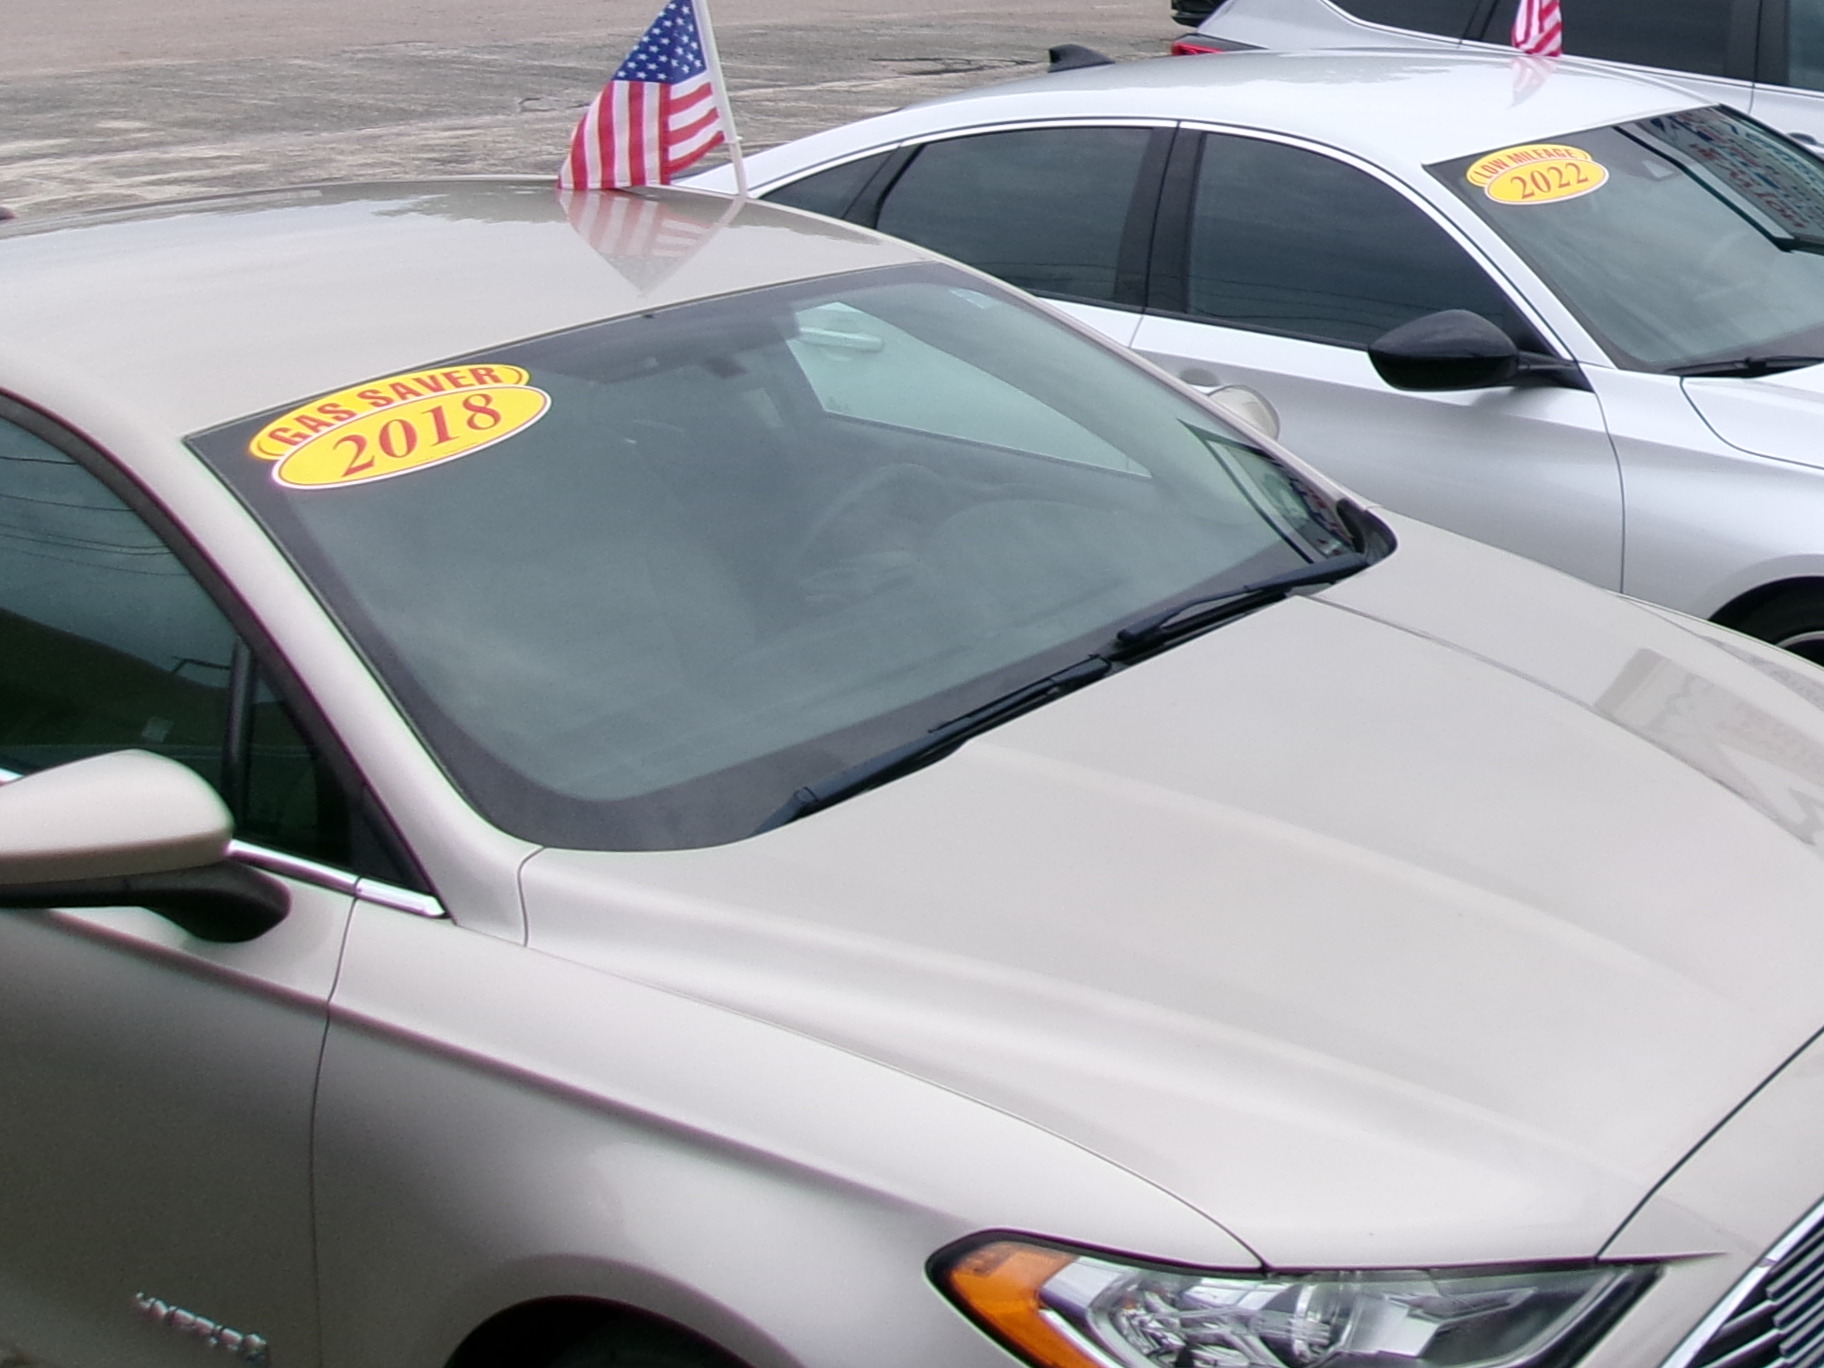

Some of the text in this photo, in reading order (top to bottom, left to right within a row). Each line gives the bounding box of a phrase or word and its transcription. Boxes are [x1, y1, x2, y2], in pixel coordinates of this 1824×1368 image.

[1474, 147, 1577, 179] LOW MILEAGE
[1510, 161, 1589, 200] 2022
[267, 365, 504, 447] GAS SAVER
[331, 392, 502, 478] 2018
